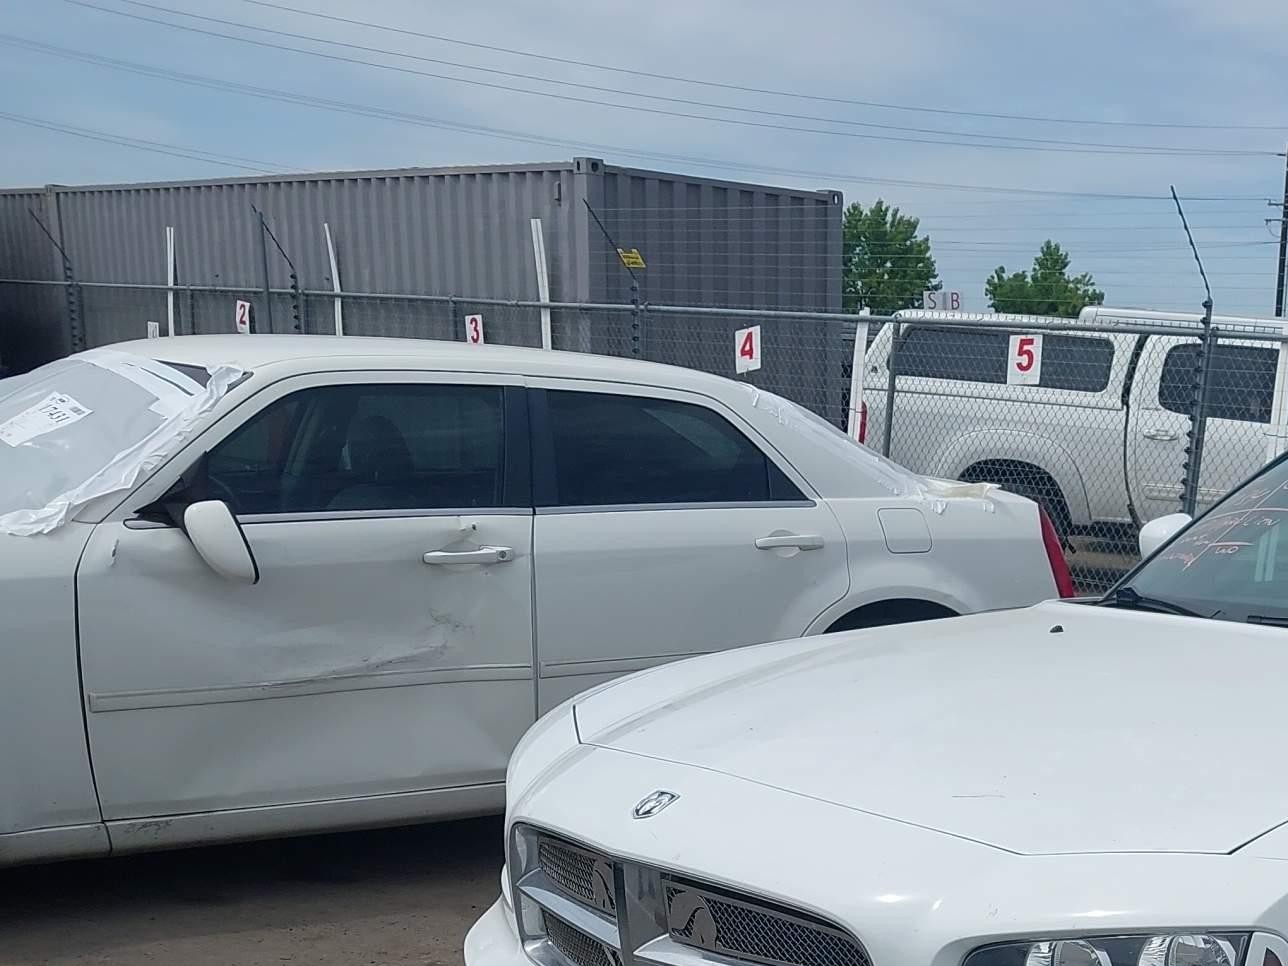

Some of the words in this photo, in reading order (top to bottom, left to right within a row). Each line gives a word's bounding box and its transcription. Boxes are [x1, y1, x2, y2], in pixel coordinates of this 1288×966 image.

[239, 303, 247, 326] 2
[927, 292, 937, 310] S
[951, 292, 960, 310] B
[469, 317, 480, 344] 3
[739, 331, 755, 360] 4
[1015, 338, 1035, 372] 5
